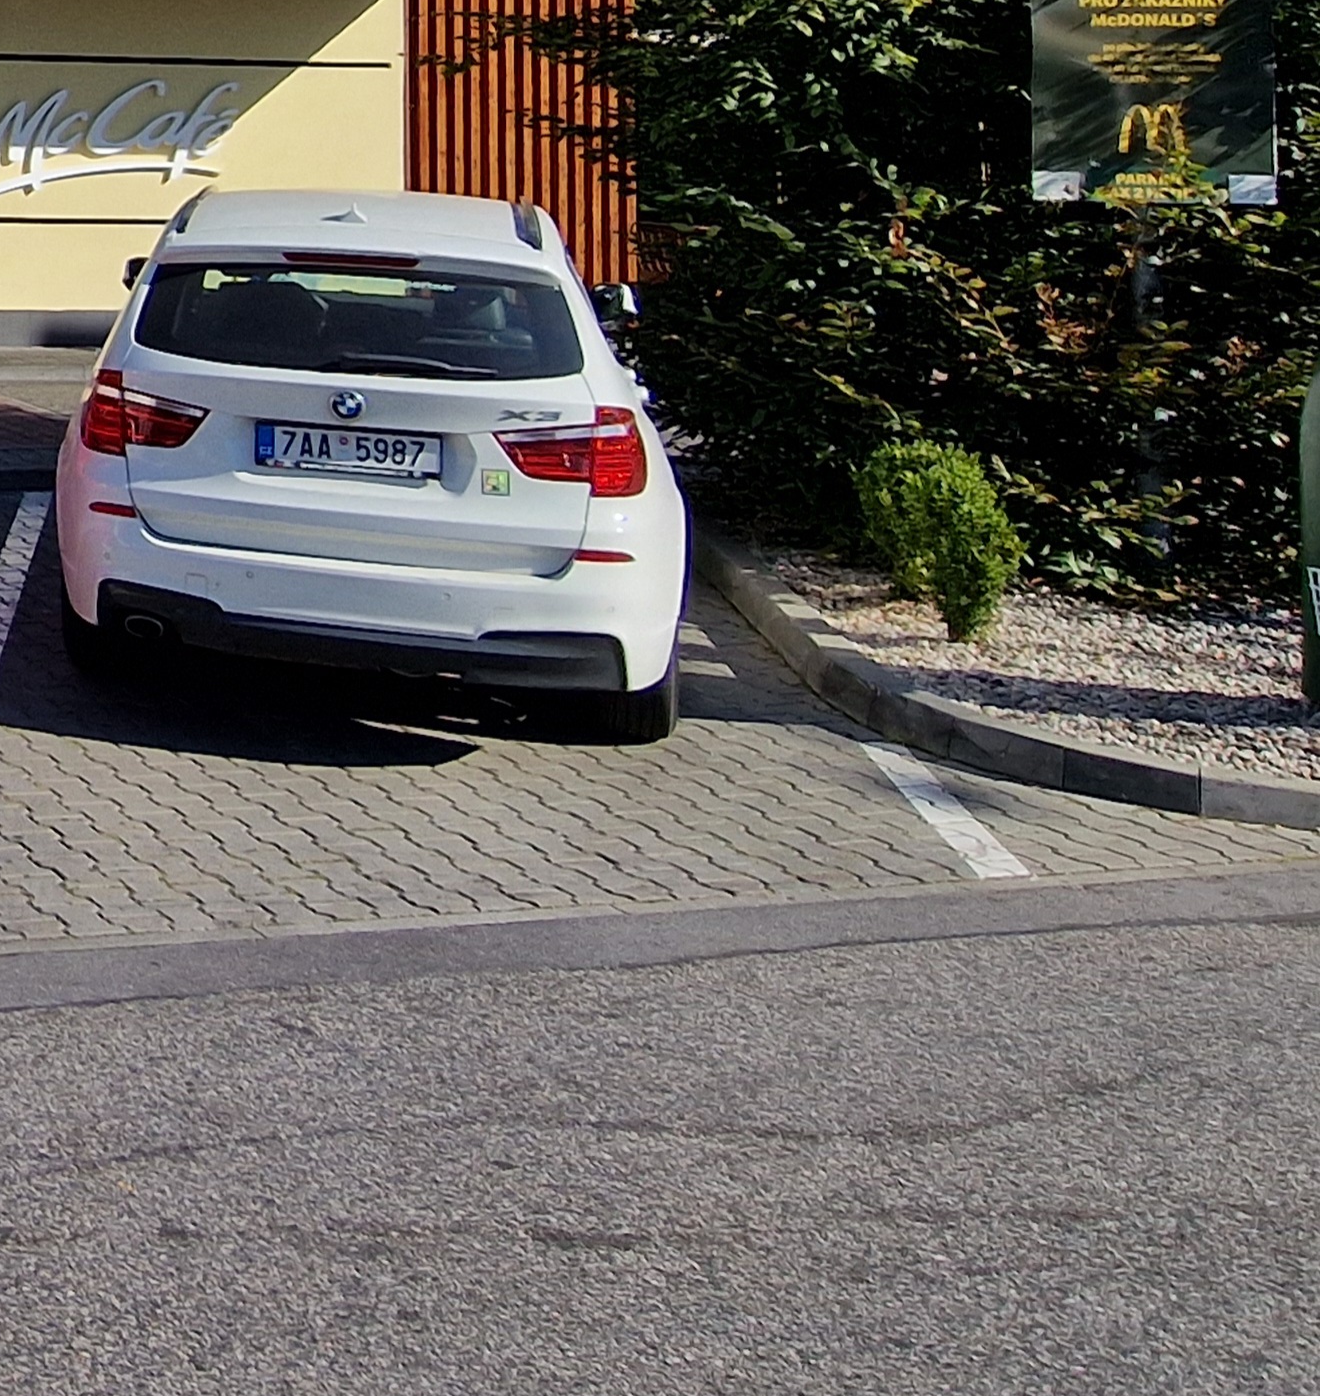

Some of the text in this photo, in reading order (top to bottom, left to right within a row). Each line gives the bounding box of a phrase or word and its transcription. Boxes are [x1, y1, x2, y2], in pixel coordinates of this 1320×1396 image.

[497, 409, 563, 422] X3
[281, 430, 332, 459] 7AA
[355, 437, 426, 467] 5987
